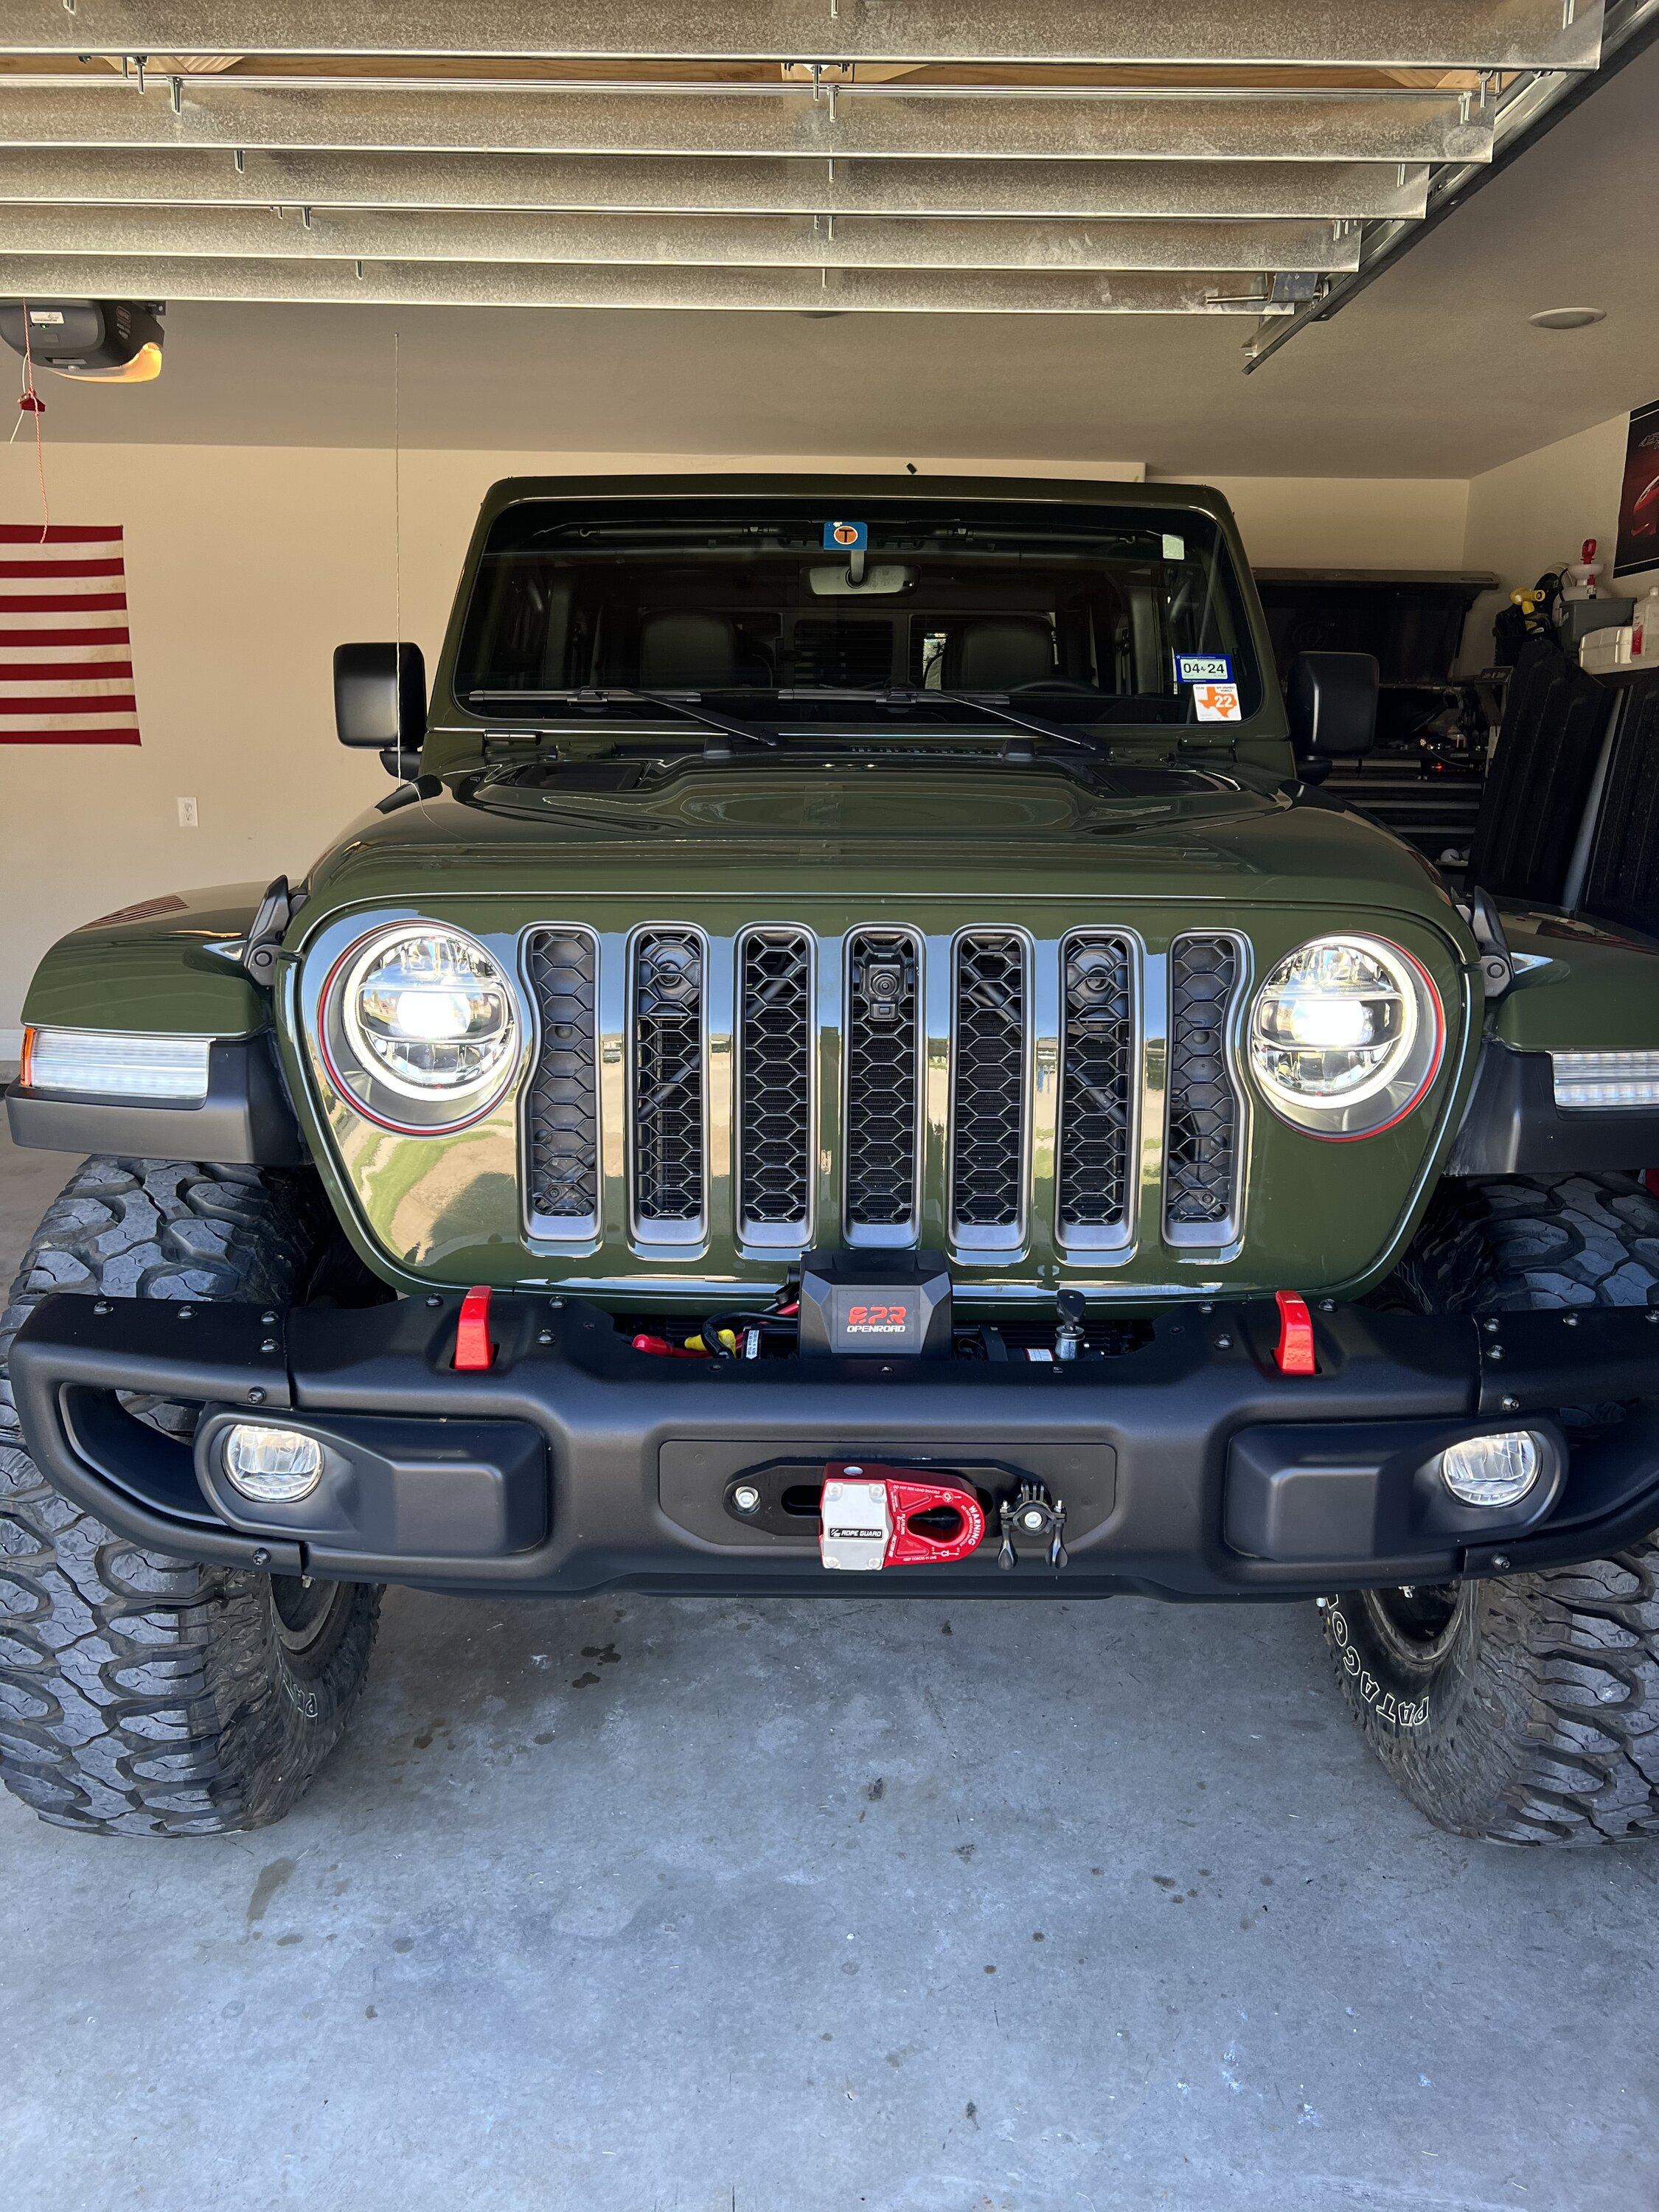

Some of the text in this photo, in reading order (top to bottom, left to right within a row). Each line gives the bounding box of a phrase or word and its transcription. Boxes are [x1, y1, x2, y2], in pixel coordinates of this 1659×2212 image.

[839, 529, 854, 543] T
[1183, 663, 1225, 673] 04 24
[1214, 695, 1234, 709] 22
[846, 1325, 906, 1333] OPENROAD
[969, 1505, 981, 1546] WARNING
